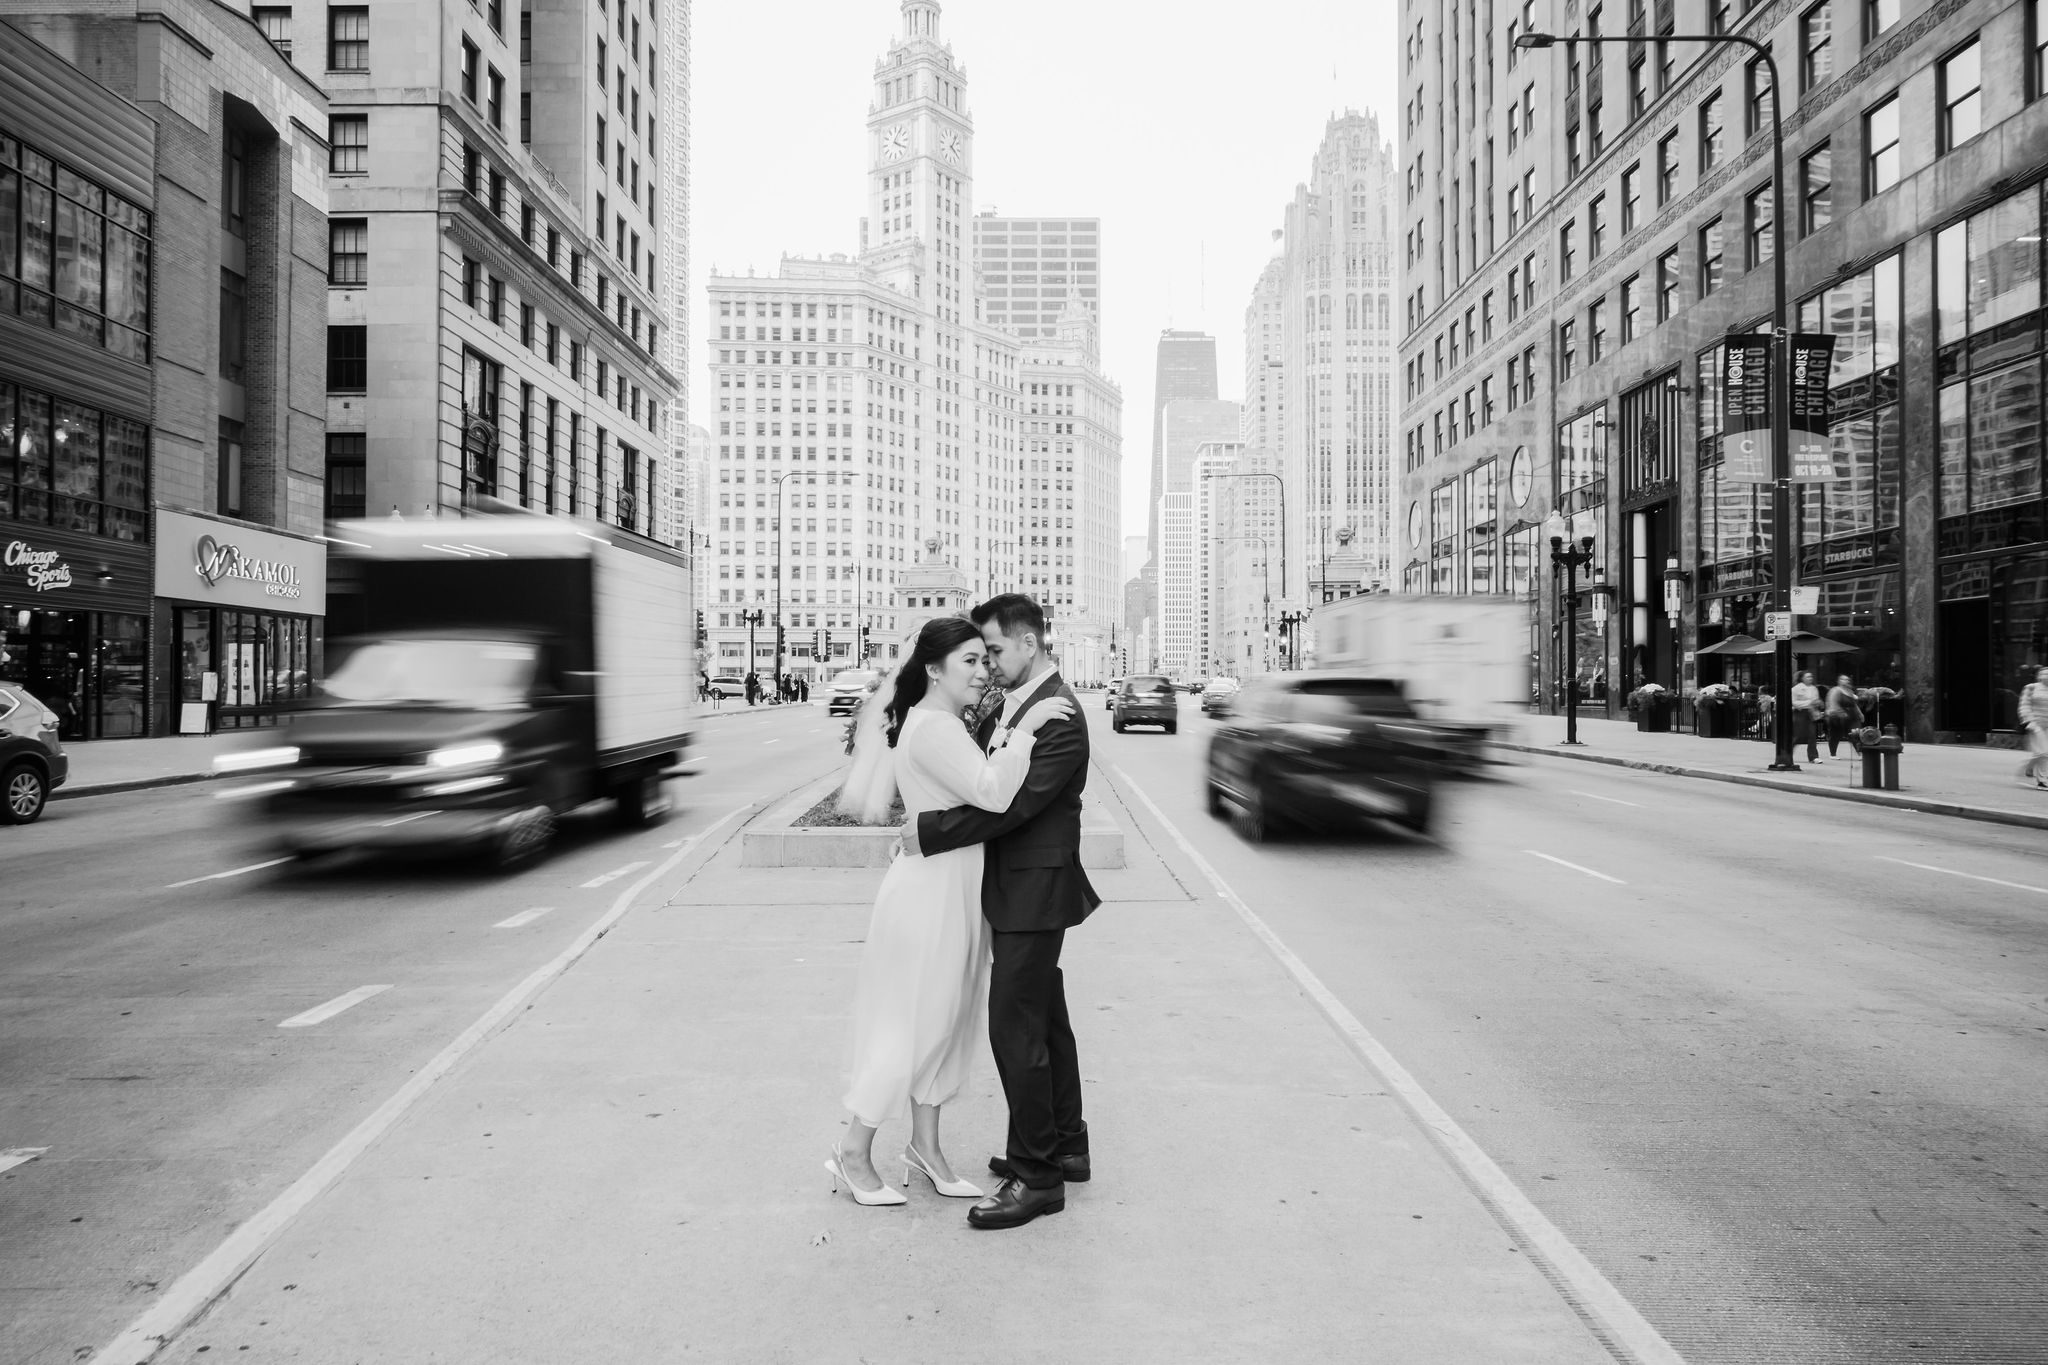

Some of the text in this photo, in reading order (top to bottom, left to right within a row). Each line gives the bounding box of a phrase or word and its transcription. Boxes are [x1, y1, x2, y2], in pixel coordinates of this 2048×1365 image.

[1745, 347, 1766, 415] CHICAGO
[1807, 349, 1829, 416] CHICAGO
[1728, 388, 1743, 415] OPEN
[1795, 388, 1806, 415] OPEN
[4, 540, 59, 569] Chicago
[1824, 547, 1873, 564] STARBUCKS
[27, 564, 73, 592] Sports
[1717, 569, 1754, 582] STARBUCKS
